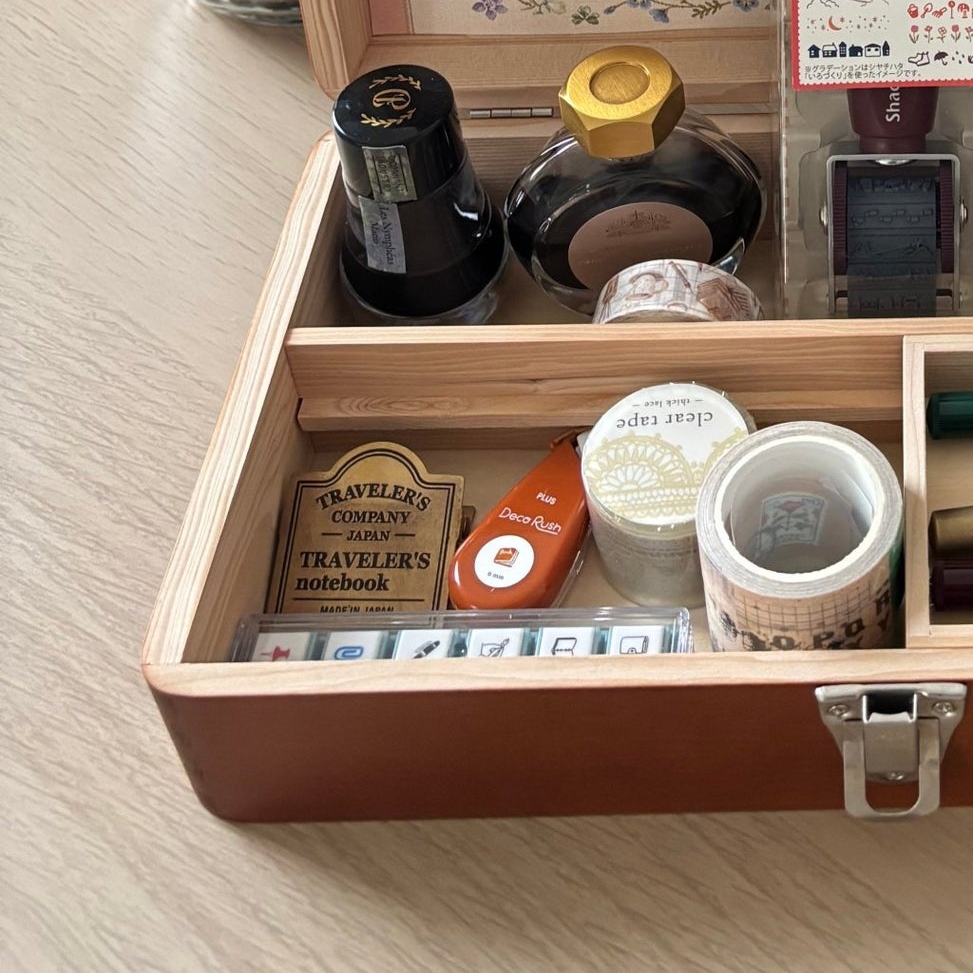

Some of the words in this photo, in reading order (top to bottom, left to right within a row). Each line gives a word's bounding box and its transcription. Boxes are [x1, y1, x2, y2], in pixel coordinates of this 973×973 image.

[644, 400, 663, 408] lace
[666, 398, 690, 407] thick
[616, 413, 657, 429] tape
[665, 411, 713, 427] clear
[315, 483, 431, 512] TRAVELER'S
[536, 492, 557, 505] PLUS
[331, 510, 411, 524] COMPANY
[347, 530, 391, 541] JAPAN
[300, 551, 431, 570] TRAVELER'S
[295, 572, 390, 592] notebook
